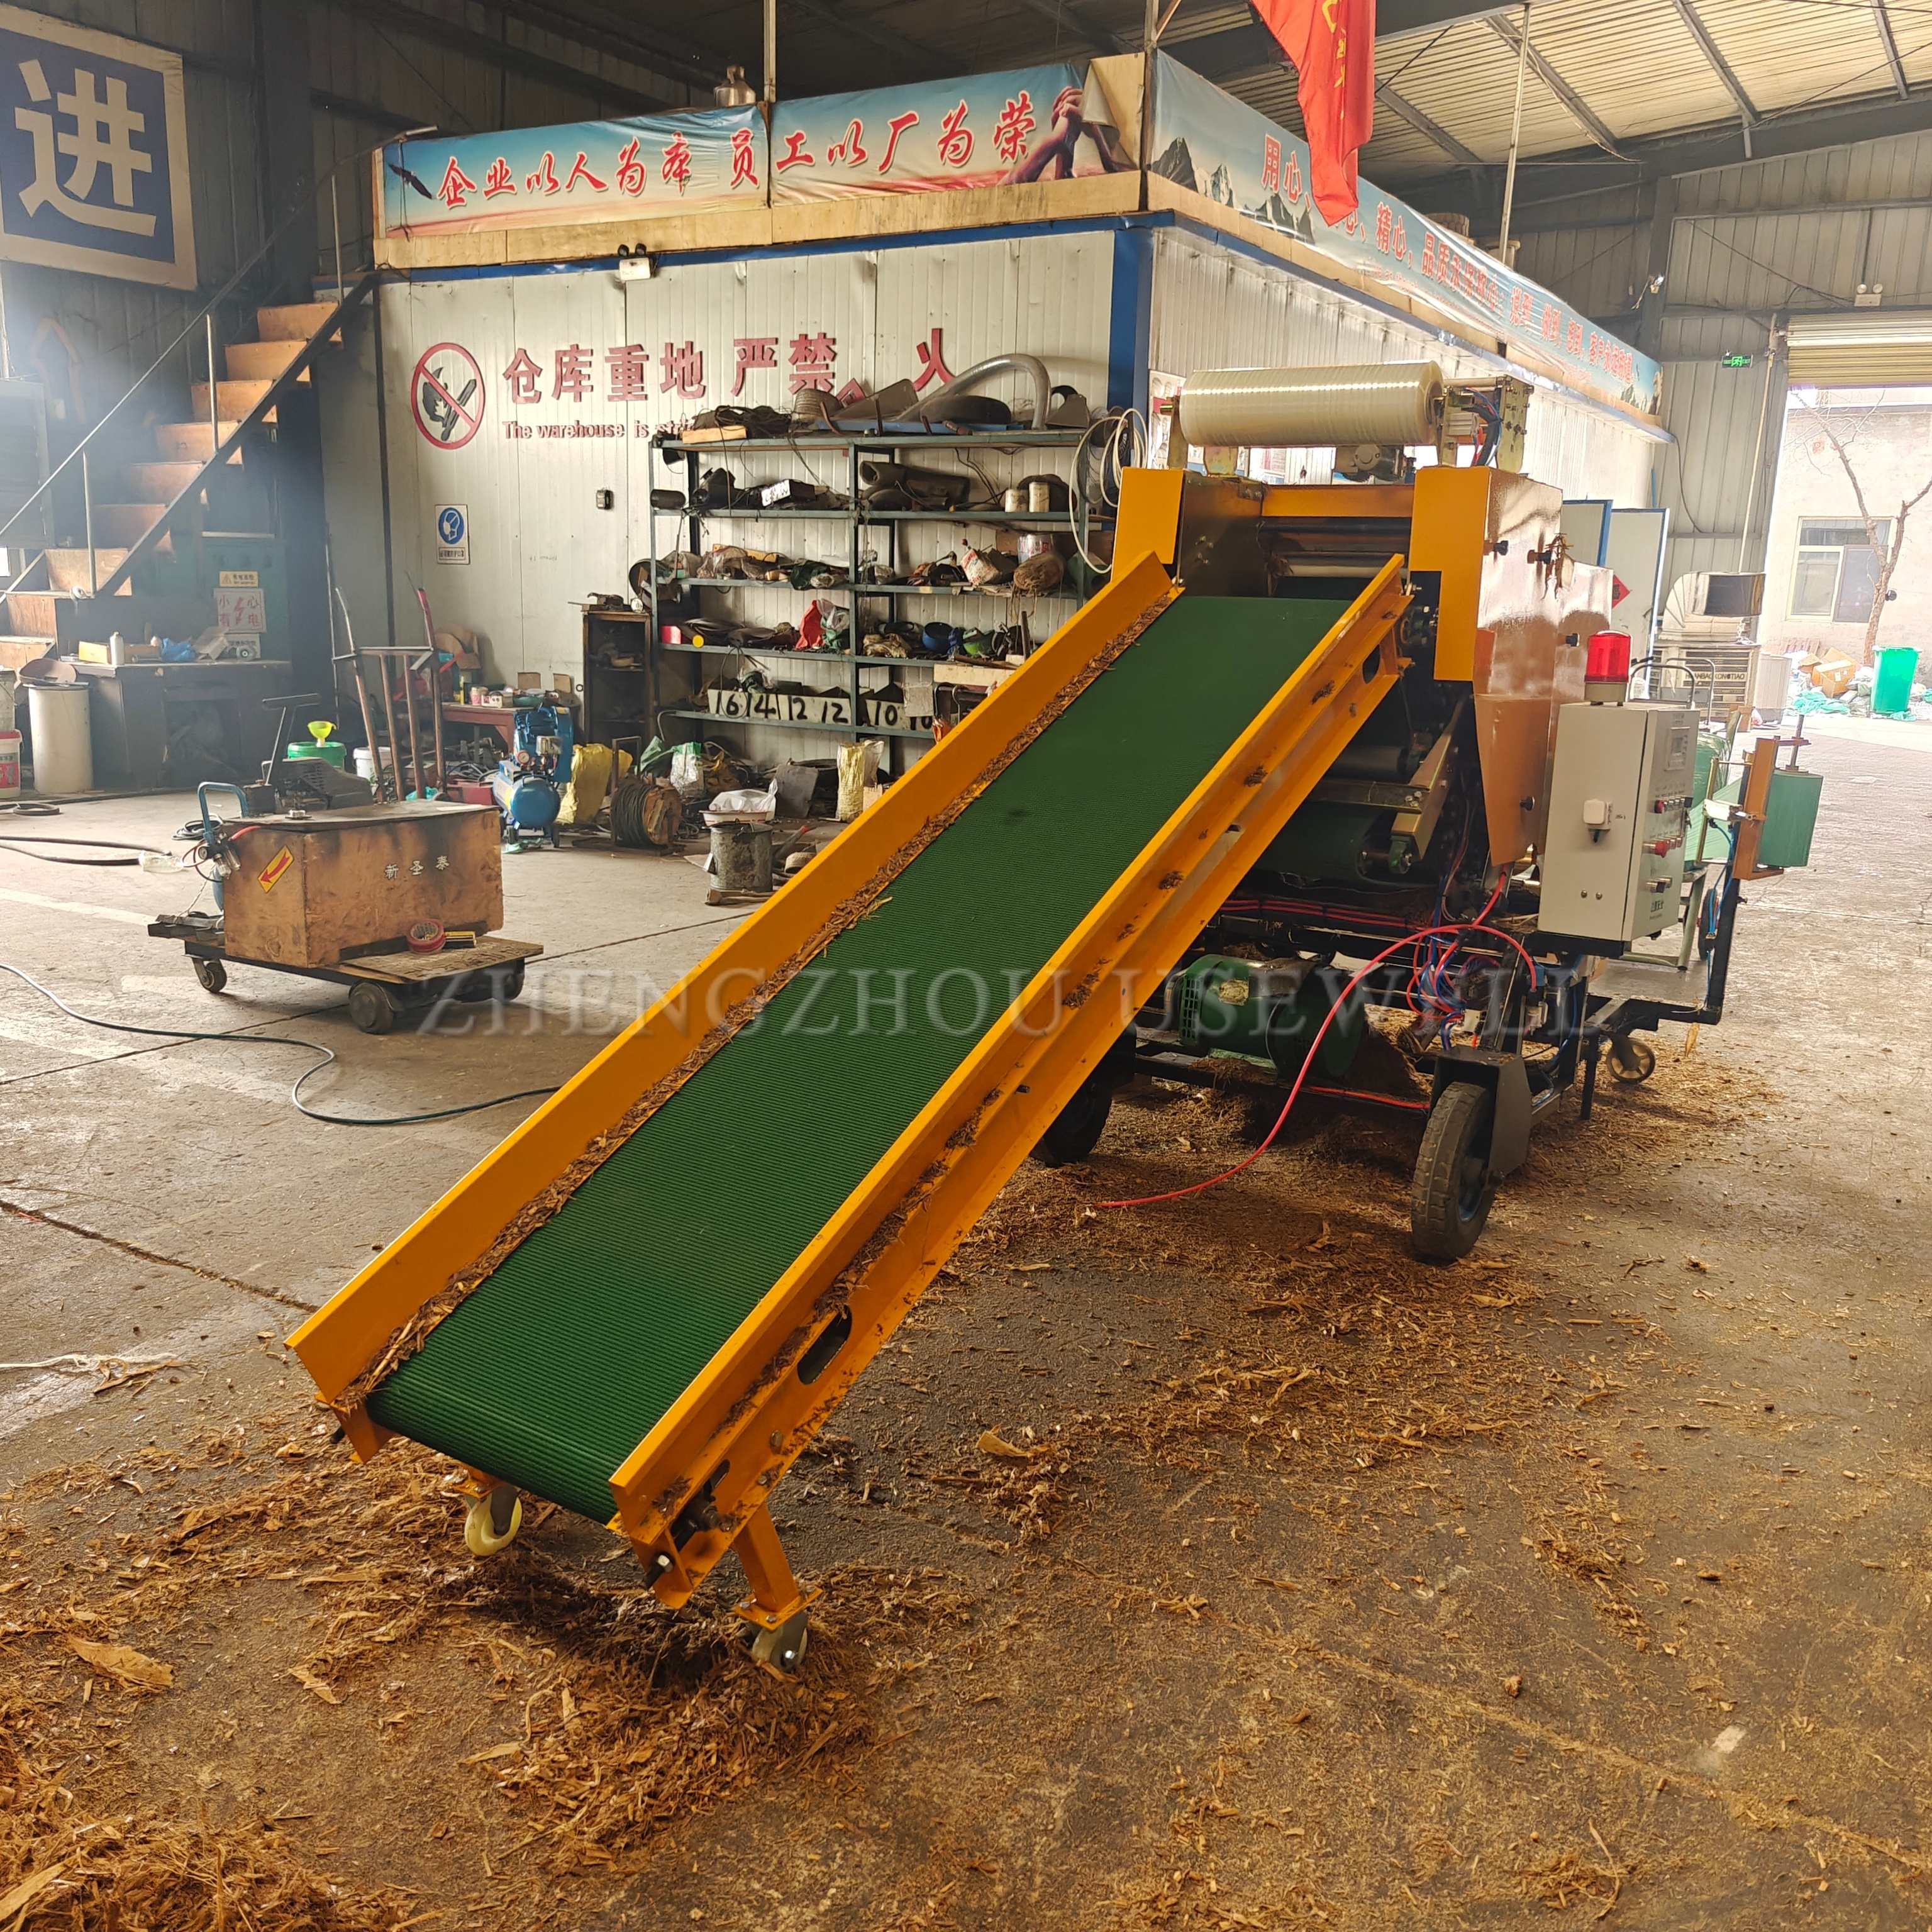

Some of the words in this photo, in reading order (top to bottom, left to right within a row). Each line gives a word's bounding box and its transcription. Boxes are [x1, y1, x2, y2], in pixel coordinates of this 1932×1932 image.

[14, 59, 156, 237] 进
[502, 341, 706, 404] 仓库重地
[731, 328, 955, 397] 严禁火
[502, 421, 532, 438] The
[536, 419, 625, 438] warehouse
[634, 420, 649, 438] is
[219, 594, 259, 608] 小心
[219, 613, 260, 627] 有电
[716, 691, 739, 715] 16
[787, 696, 808, 721] 12
[821, 701, 848, 723] 12
[875, 701, 897, 726] 10
[385, 856, 450, 879] 新圣泰
